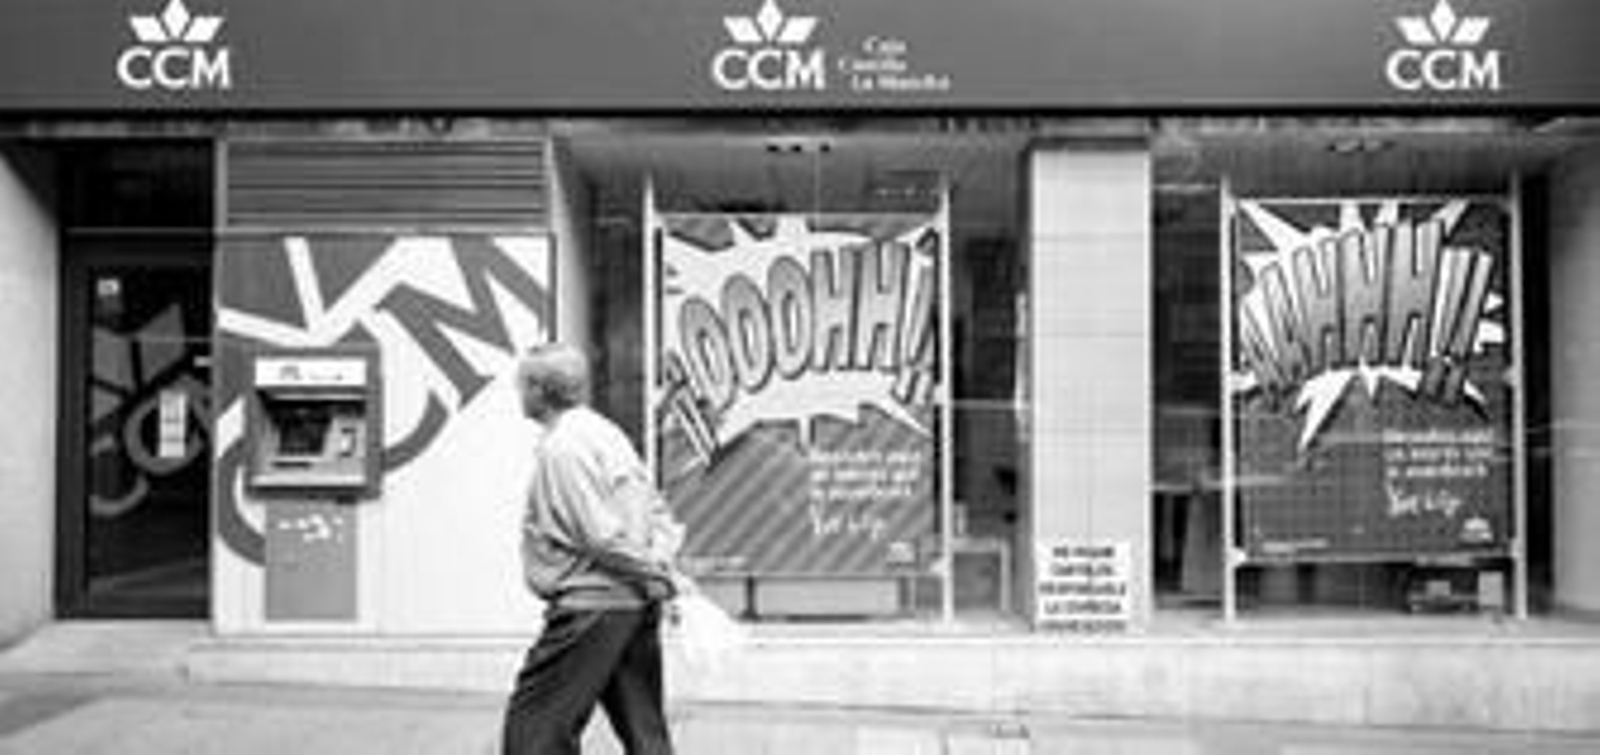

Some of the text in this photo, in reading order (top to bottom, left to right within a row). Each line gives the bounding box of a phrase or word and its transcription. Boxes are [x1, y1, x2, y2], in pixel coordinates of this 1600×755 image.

[117, 46, 230, 90] CCM
[712, 48, 825, 90] CCM
[1386, 48, 1500, 90] CCM
